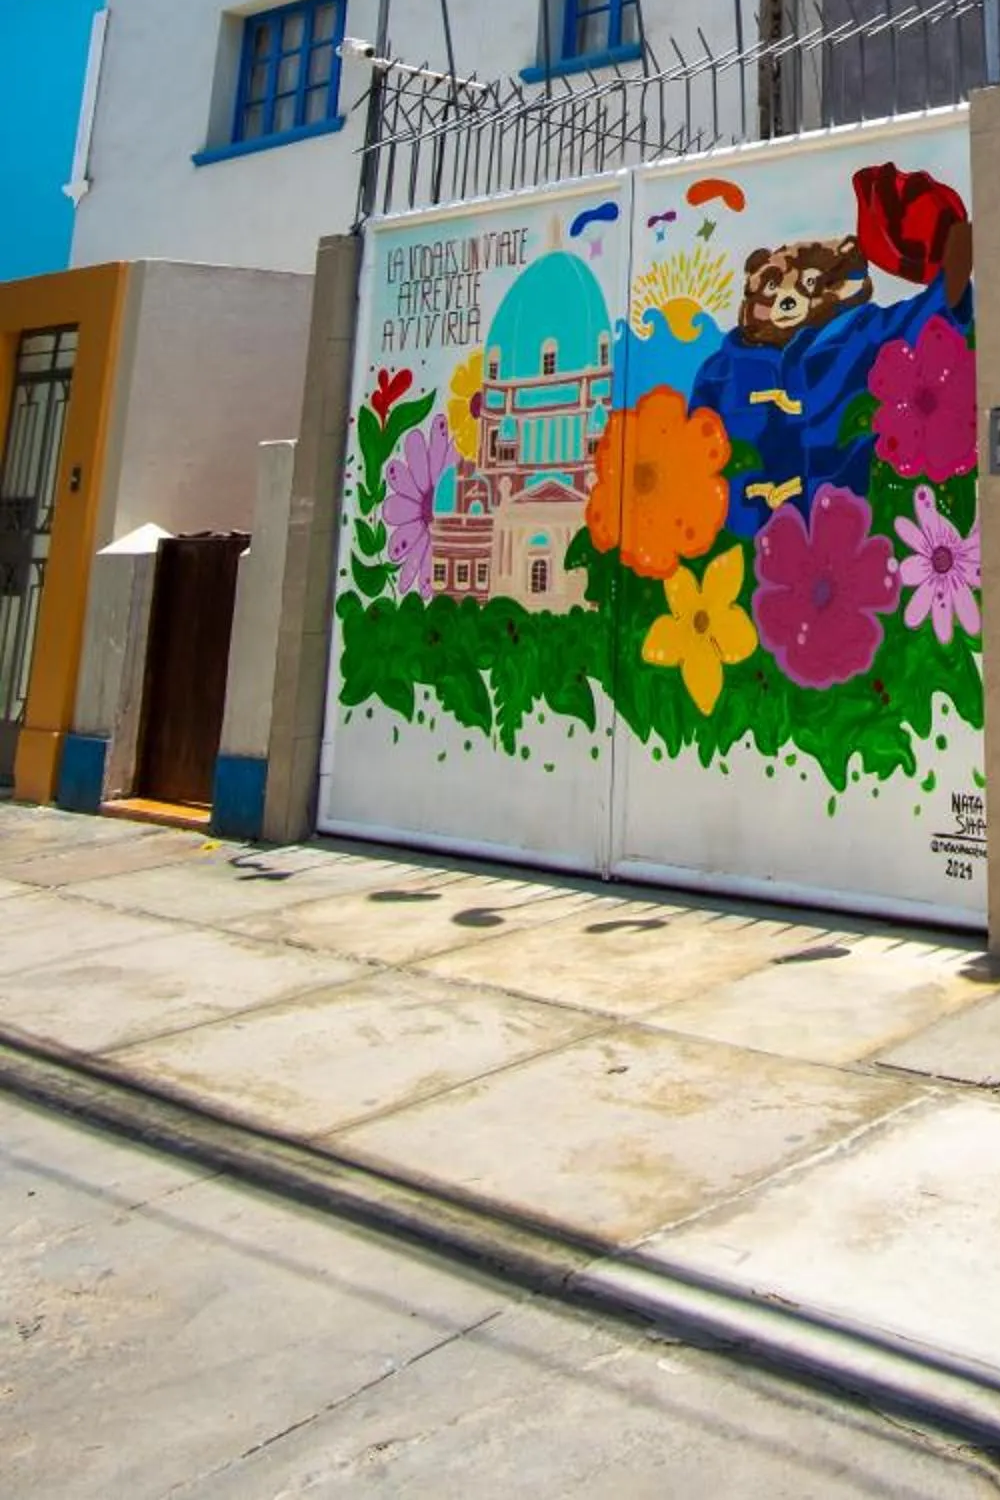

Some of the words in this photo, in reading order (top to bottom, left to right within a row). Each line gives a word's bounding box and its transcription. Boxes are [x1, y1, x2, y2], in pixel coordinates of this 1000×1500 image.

[387, 246, 404, 284] LA
[461, 237, 481, 273] UN
[398, 271, 482, 316] ATREVETE
[382, 320, 394, 352] A
[399, 307, 483, 351] VIVIRLA
[951, 791, 984, 815] NATA
